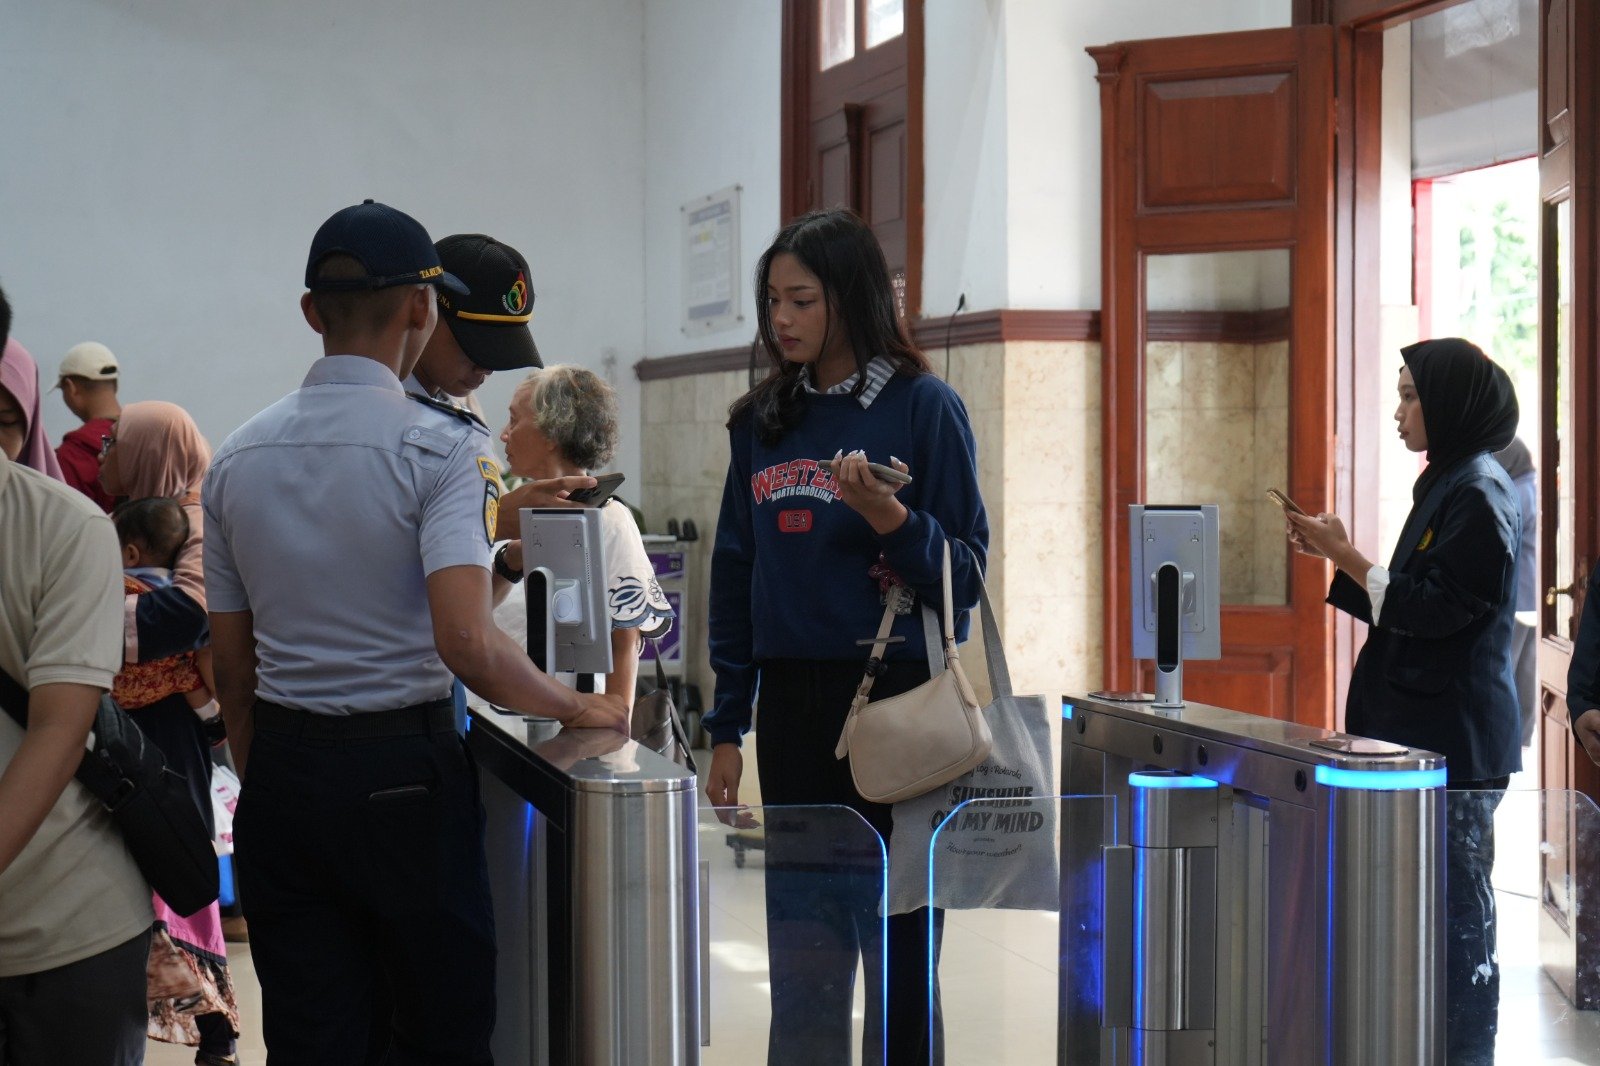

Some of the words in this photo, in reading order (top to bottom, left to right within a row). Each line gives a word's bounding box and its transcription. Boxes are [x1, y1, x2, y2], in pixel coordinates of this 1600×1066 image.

[751, 458, 843, 505] WESTER
[771, 487, 794, 502] NORTH
[948, 785, 1034, 808] SUNSHINE
[929, 809, 959, 832] ON
[959, 812, 993, 832] MY
[992, 812, 1044, 833] MIND
